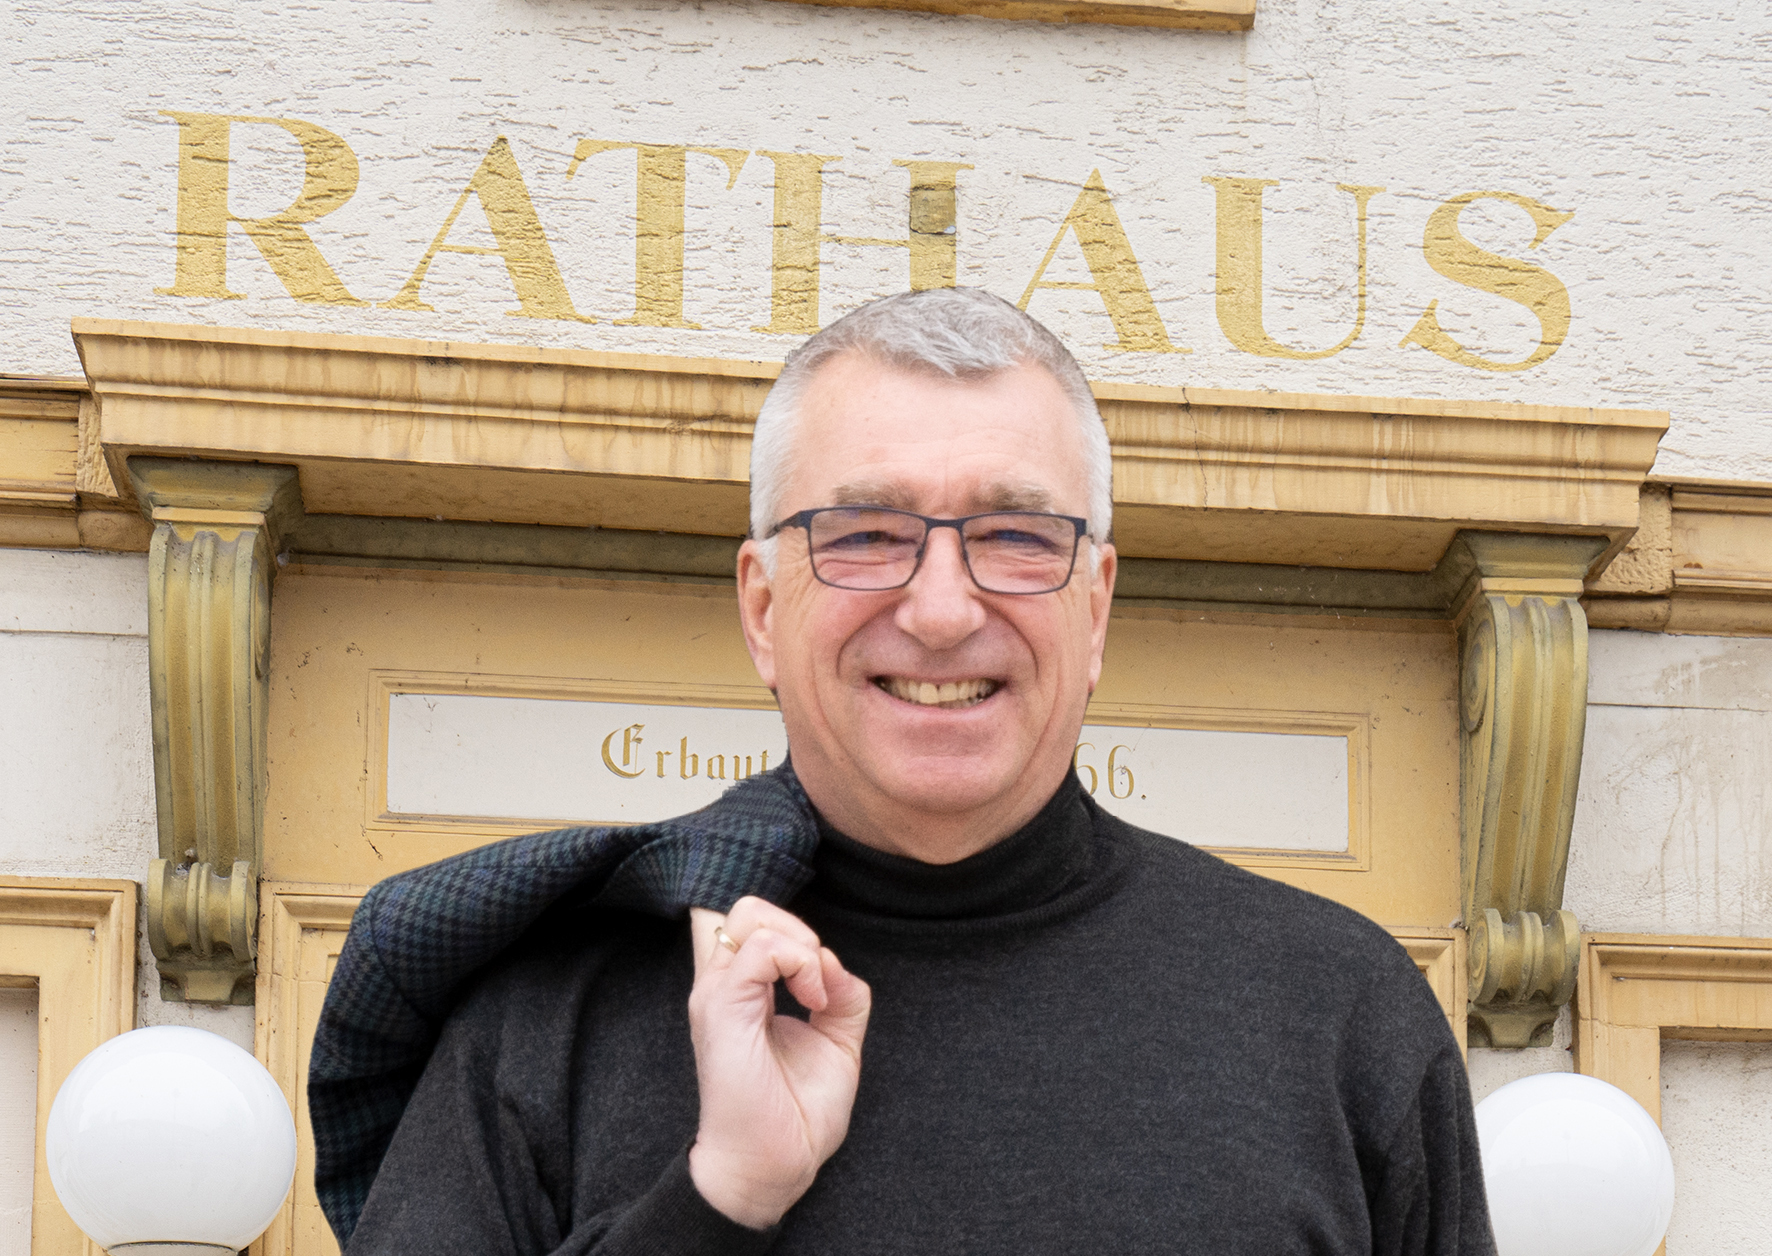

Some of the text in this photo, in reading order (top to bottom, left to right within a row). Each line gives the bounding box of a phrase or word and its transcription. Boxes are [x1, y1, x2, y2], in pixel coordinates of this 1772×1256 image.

[153, 109, 1575, 371] RATHAUS
[601, 723, 1147, 800] Erbaut 66.
